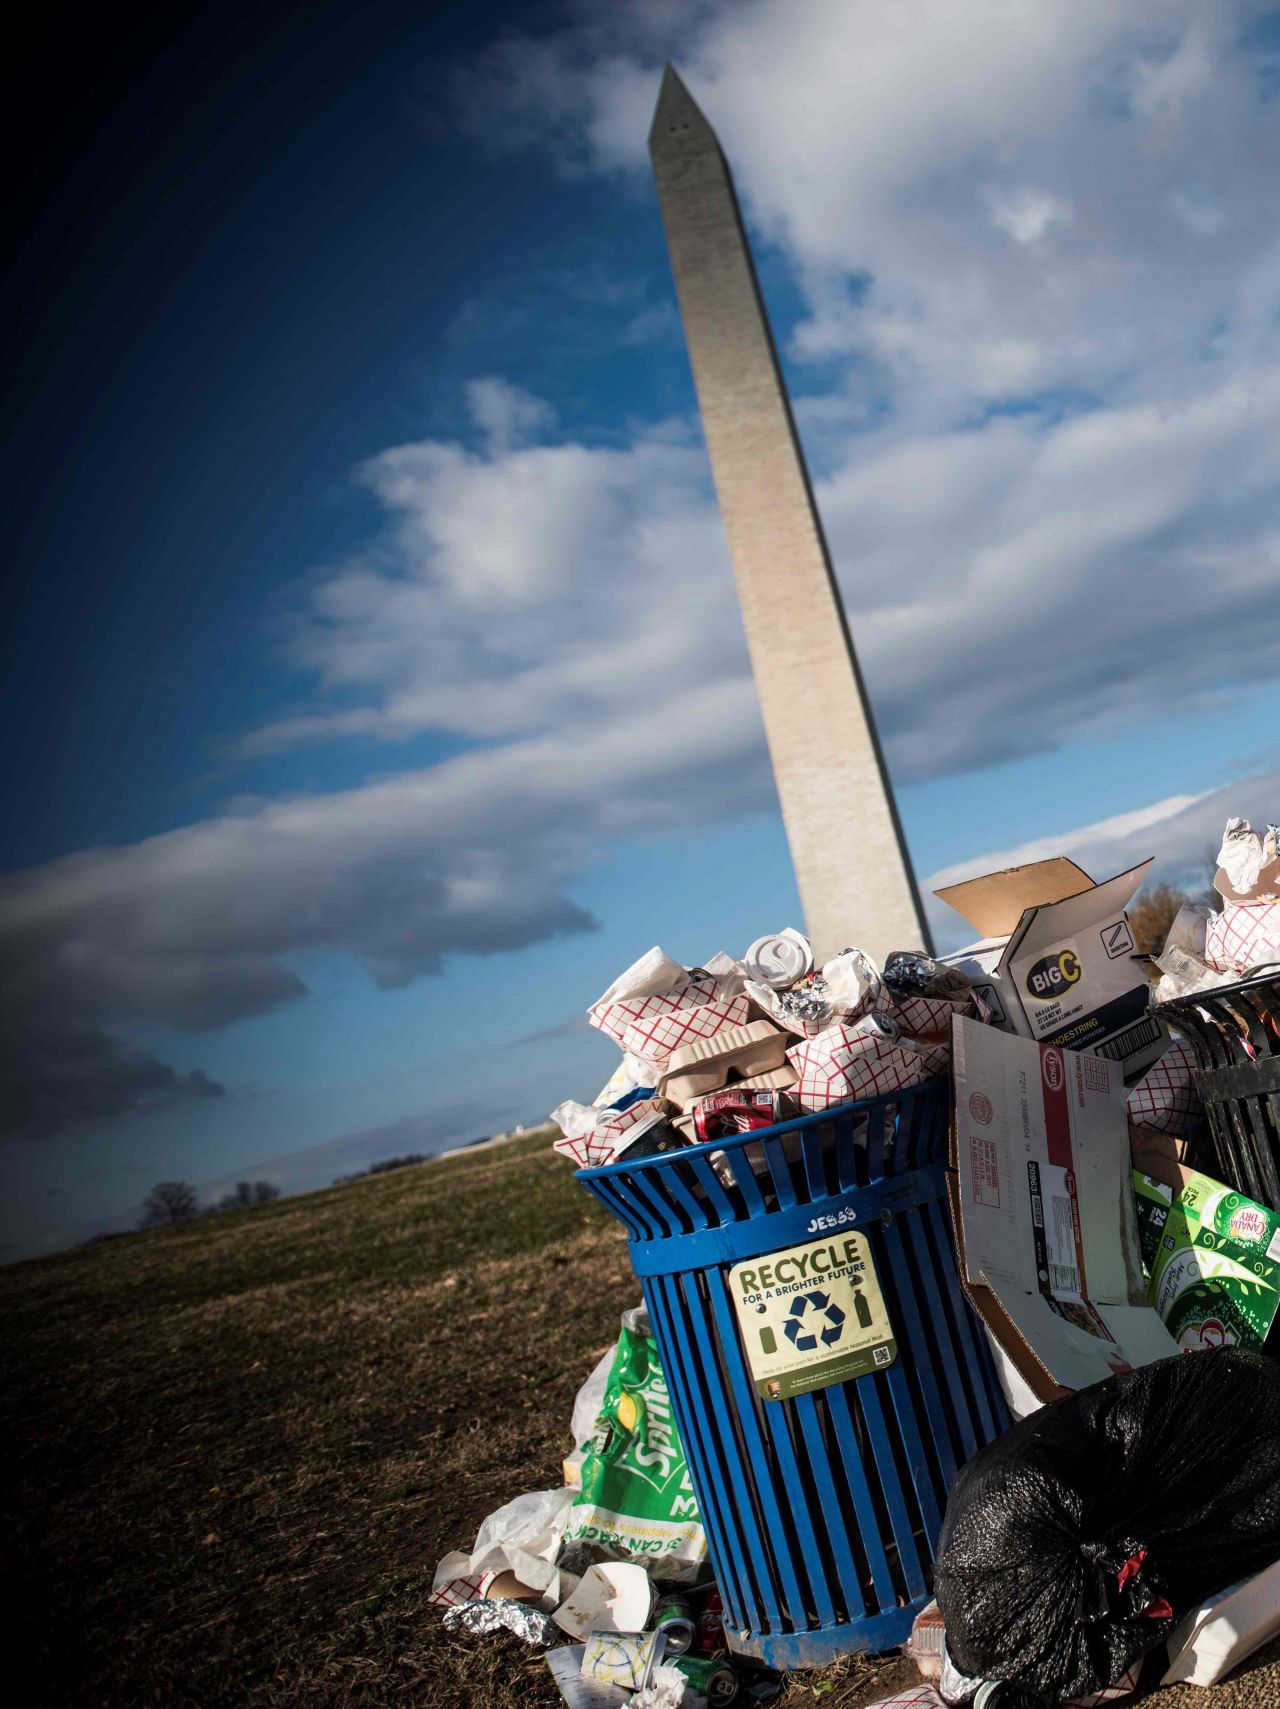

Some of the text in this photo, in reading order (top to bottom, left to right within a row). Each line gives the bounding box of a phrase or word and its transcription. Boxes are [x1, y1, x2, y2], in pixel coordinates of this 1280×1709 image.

[1032, 965, 1061, 992] BIG
[1048, 1018, 1098, 1046] HOESTRING
[1046, 1051, 1059, 1088] Tyson
[1029, 1161, 1038, 1193] 20963
[1182, 1191, 1198, 1207] 24
[1187, 1186, 1200, 1195] PACK
[1149, 1206, 1157, 1222] PACK
[1153, 1207, 1168, 1227] 24
[1238, 1211, 1260, 1223] DRY
[1229, 1218, 1266, 1236] CANADA
[739, 1238, 861, 1294] RECYCLE
[743, 1261, 866, 1306] FOR A BRIGHTER FUTURE
[820, 1346, 849, 1359] sustainable
[850, 1338, 872, 1350] National
[634, 1372, 678, 1478] Sprite
[629, 1537, 663, 1553] CAN
